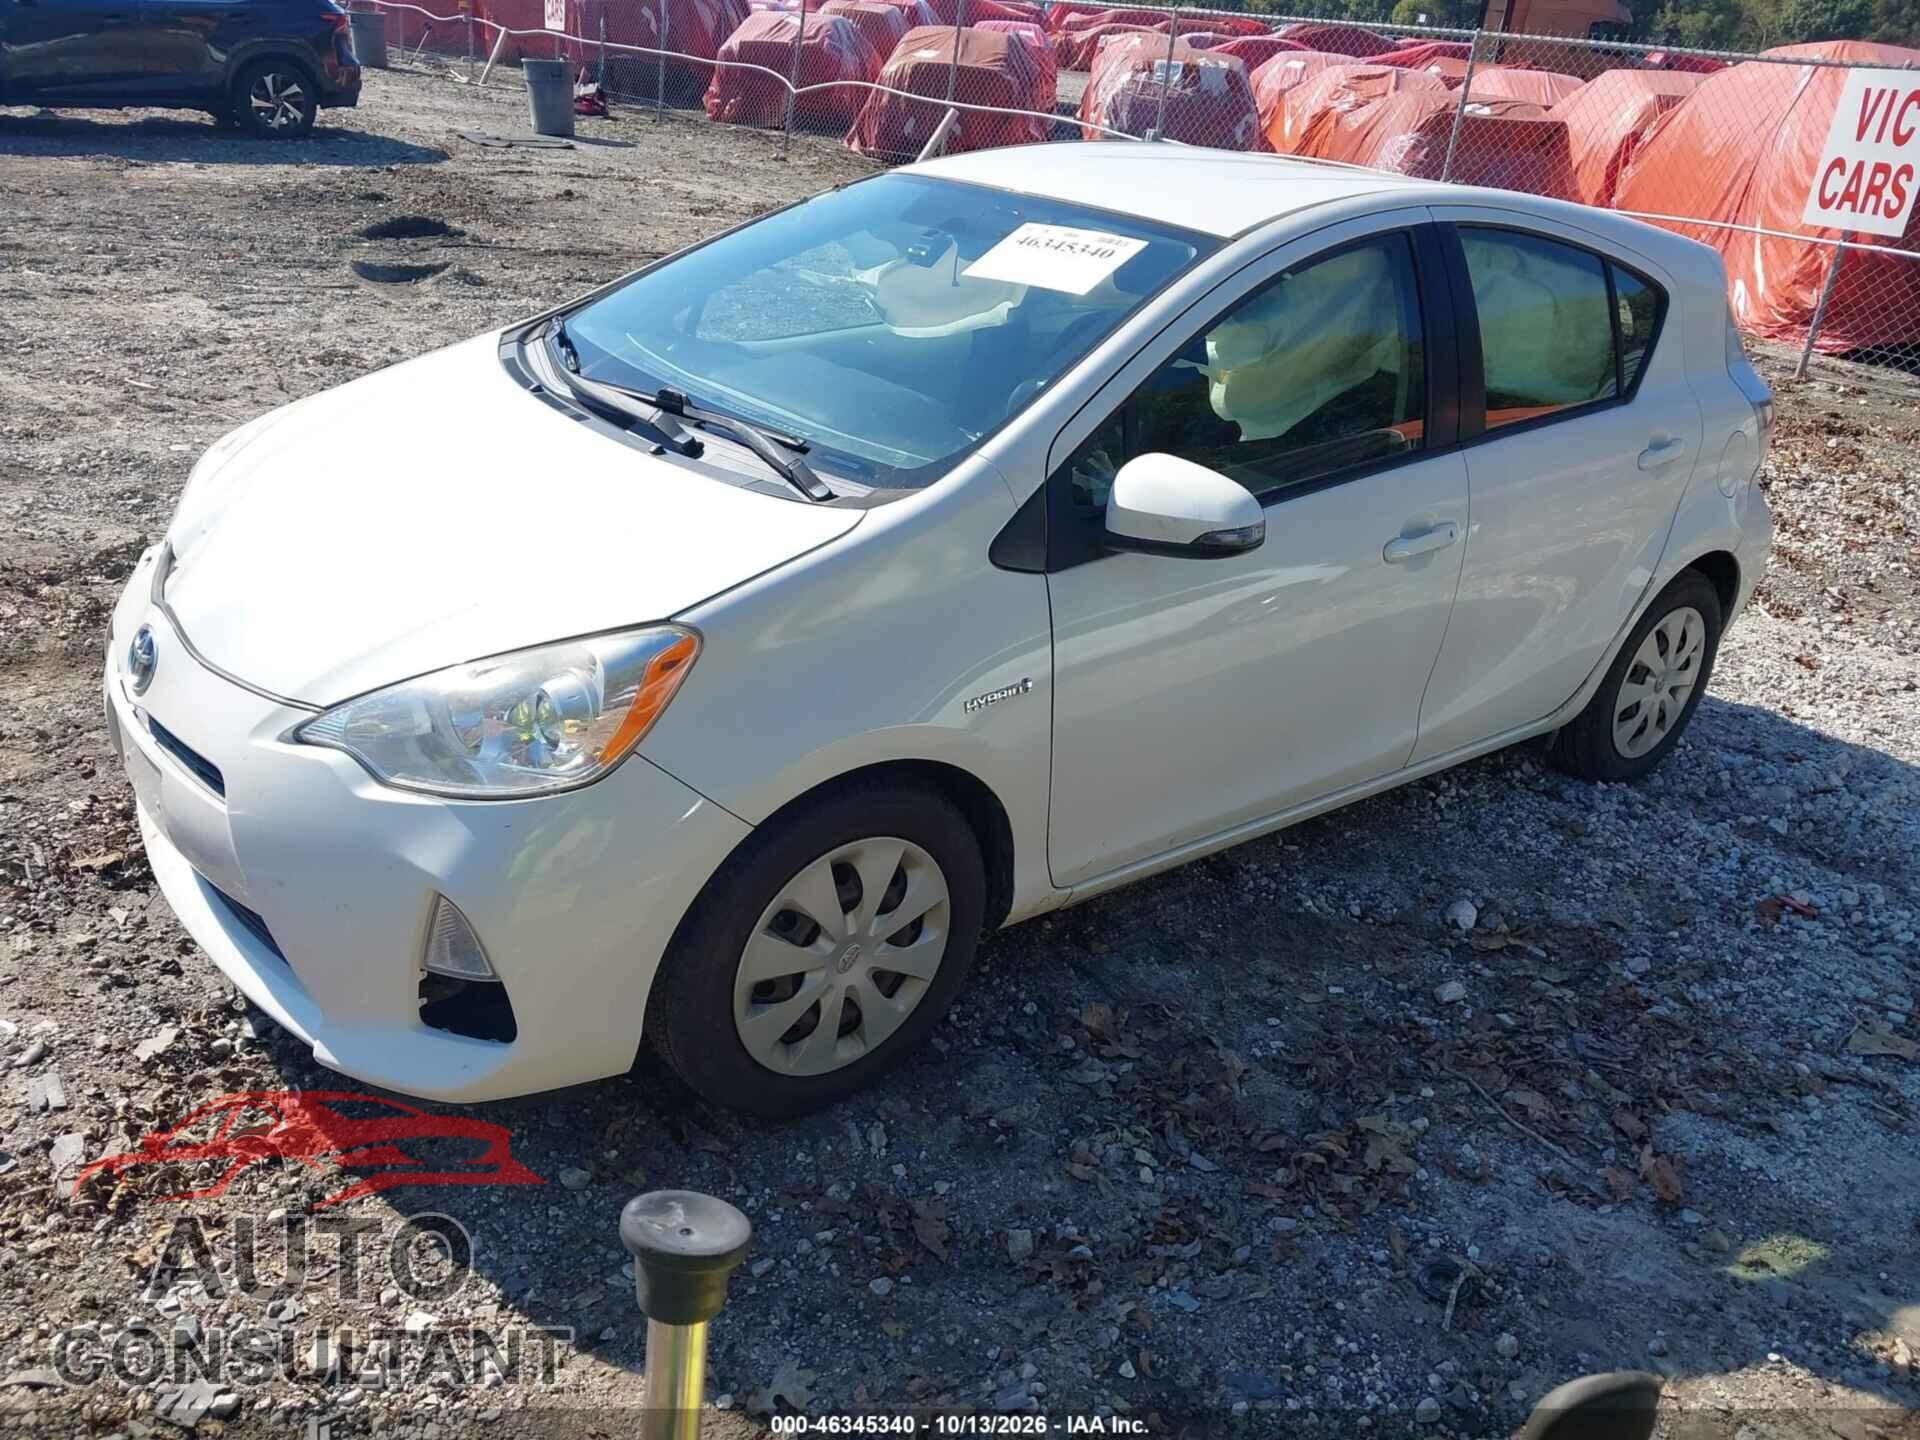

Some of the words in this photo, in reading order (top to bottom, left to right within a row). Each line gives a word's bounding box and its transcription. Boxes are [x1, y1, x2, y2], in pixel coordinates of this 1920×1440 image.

[1856, 87, 1920, 147] VIC
[1817, 156, 1914, 219] CARS
[1016, 236, 1116, 259] 46345340
